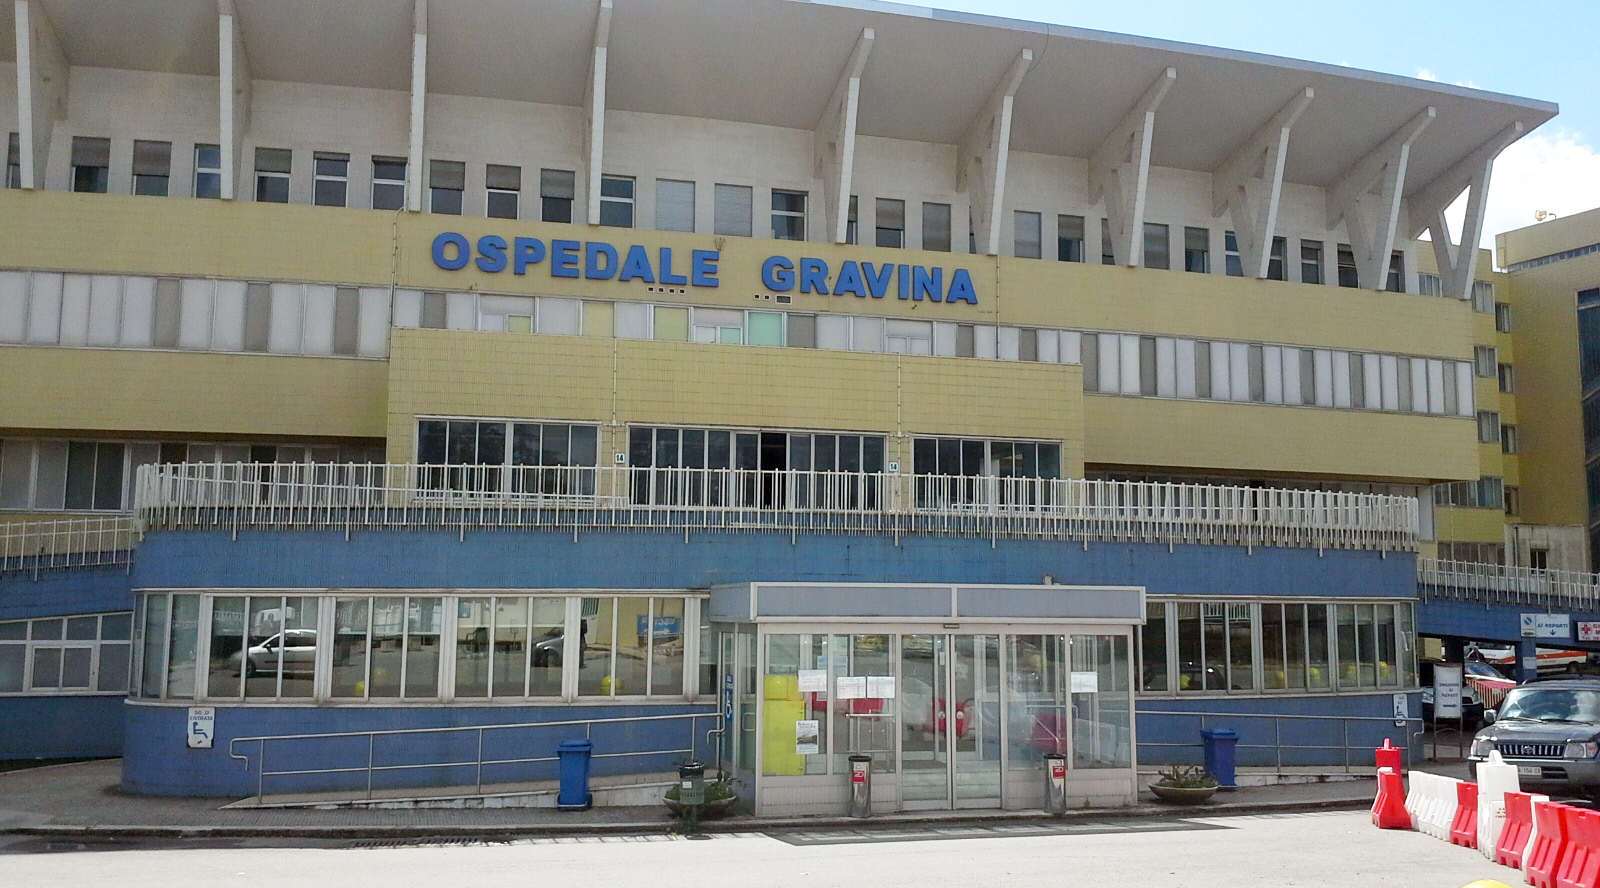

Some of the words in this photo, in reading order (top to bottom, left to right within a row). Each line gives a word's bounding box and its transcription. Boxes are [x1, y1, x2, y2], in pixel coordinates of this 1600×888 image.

[431, 231, 720, 287] OSPEDALE
[761, 255, 978, 305] GRAVINA
[616, 453, 624, 462] 14
